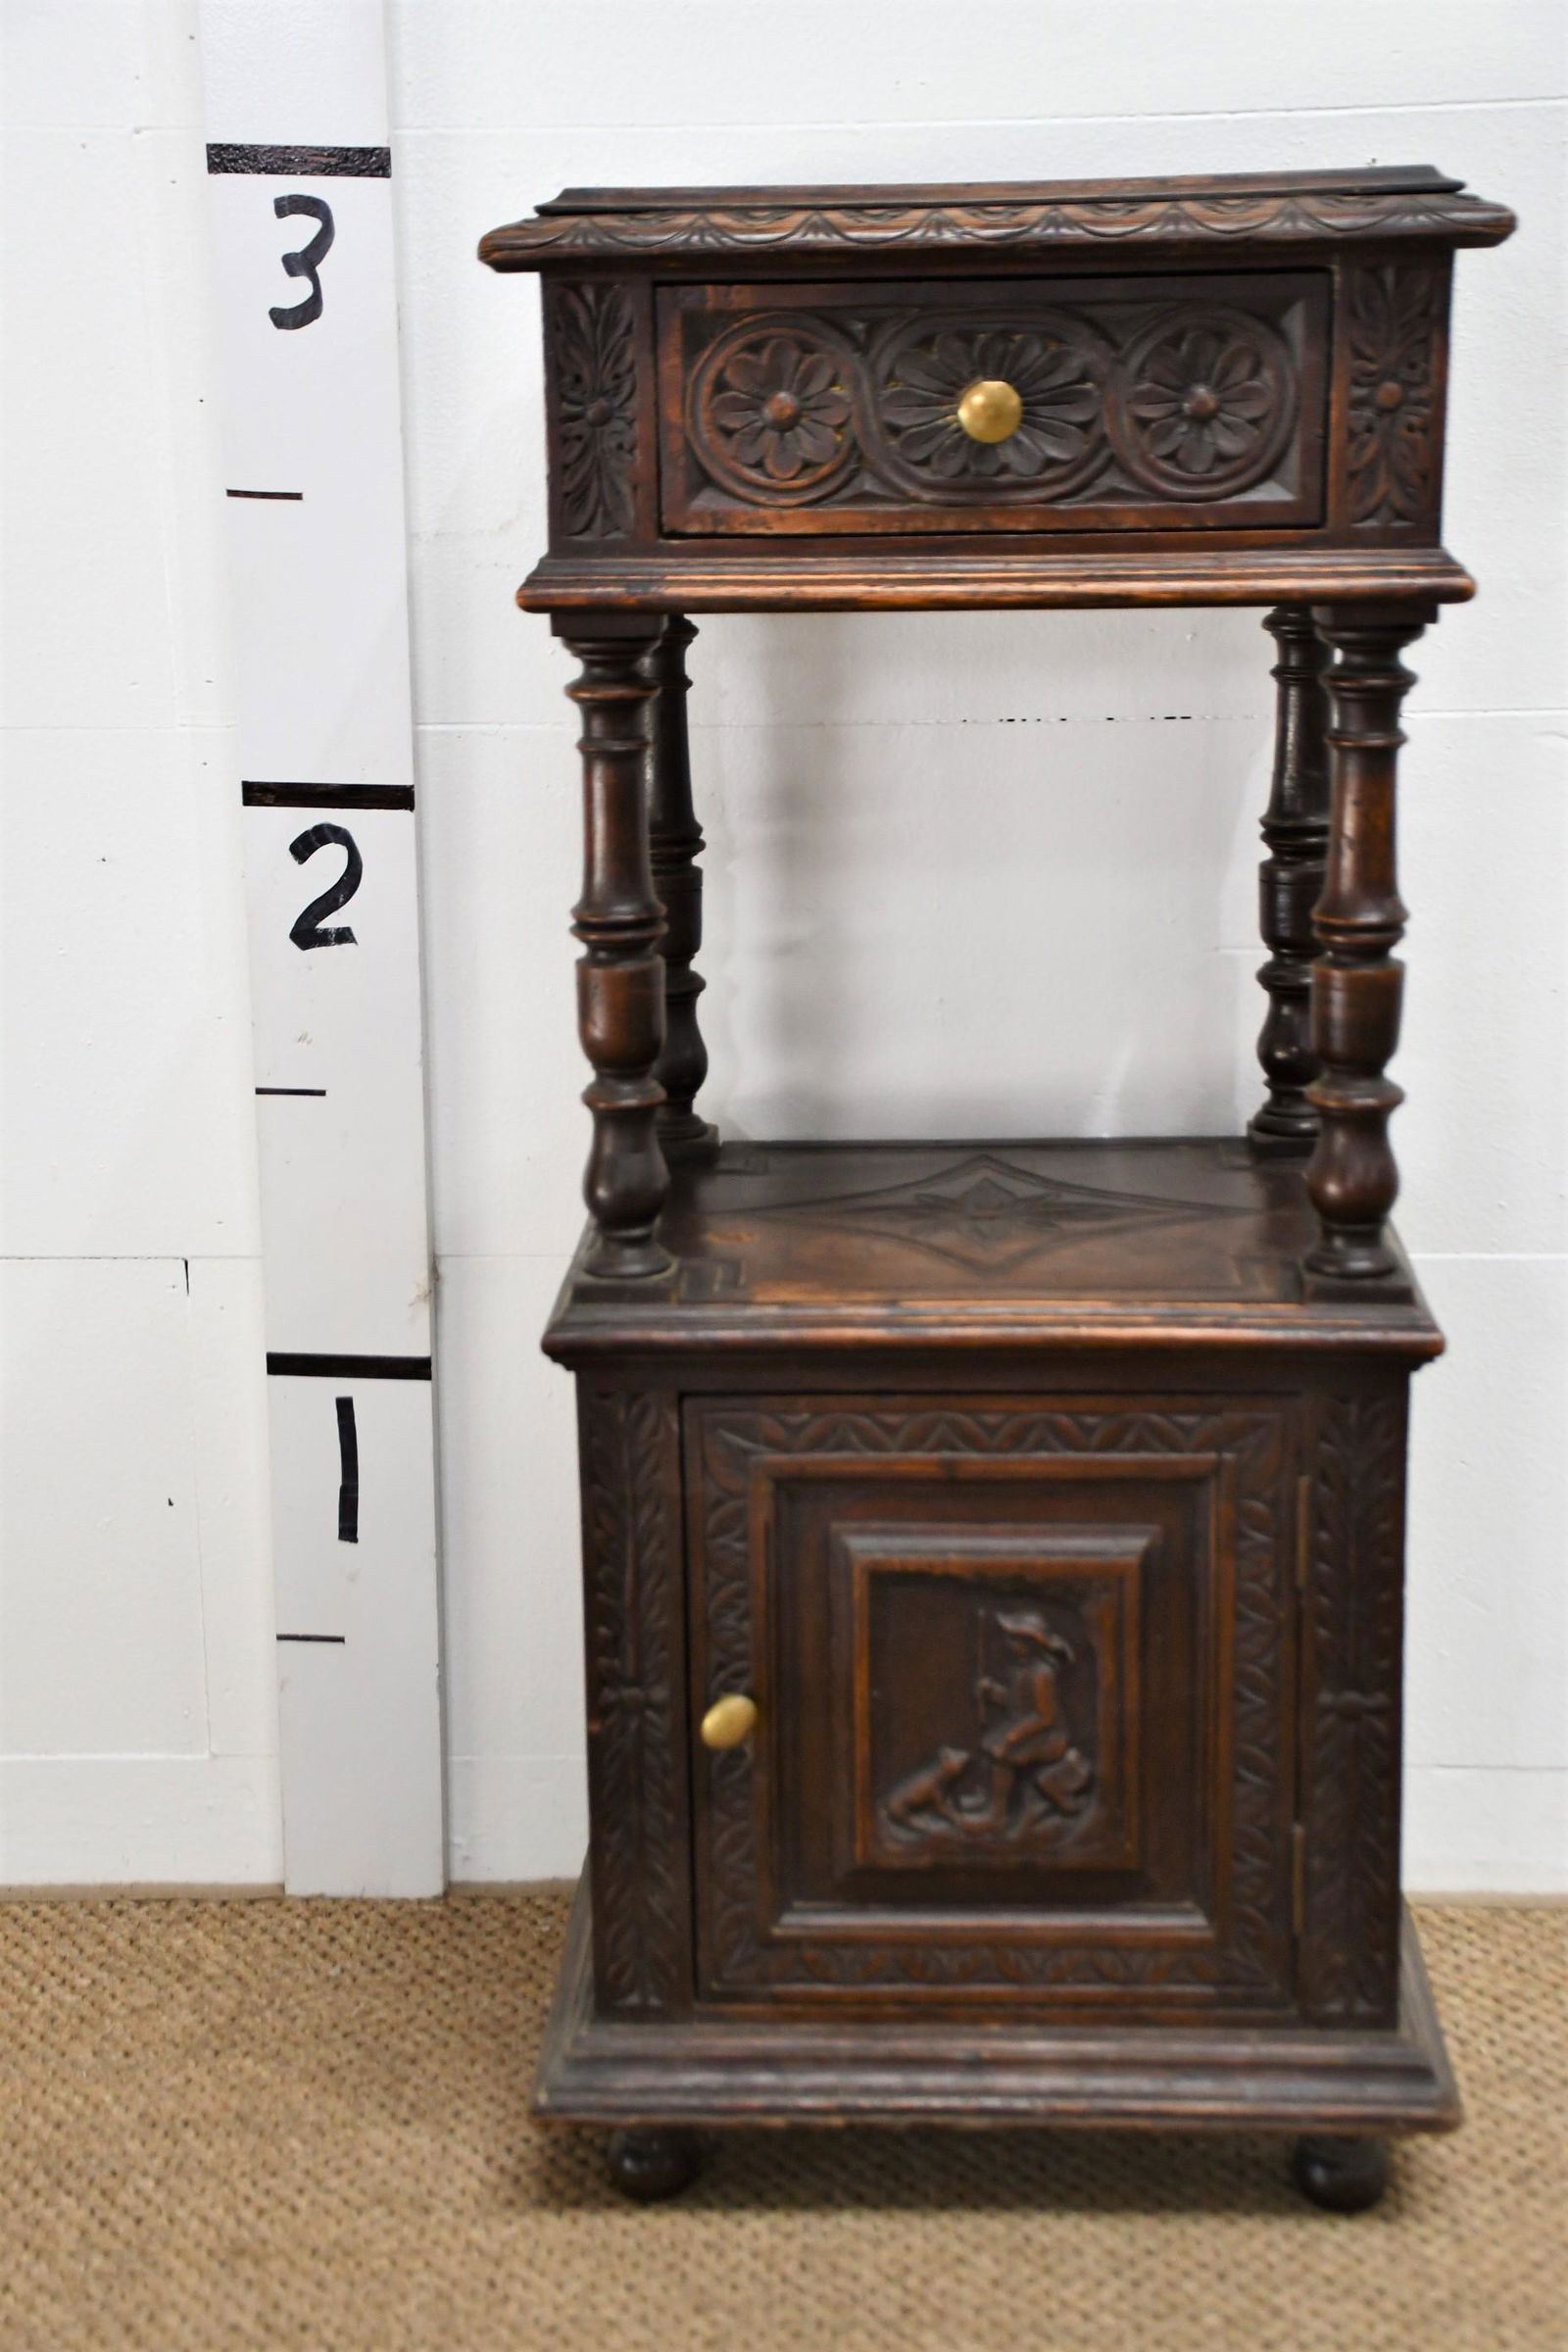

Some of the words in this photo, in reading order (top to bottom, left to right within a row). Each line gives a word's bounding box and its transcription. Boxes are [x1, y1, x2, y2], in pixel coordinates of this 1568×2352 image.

[269, 194, 335, 330] 3
[288, 822, 364, 951] 2
[335, 1396, 359, 1544] 1
